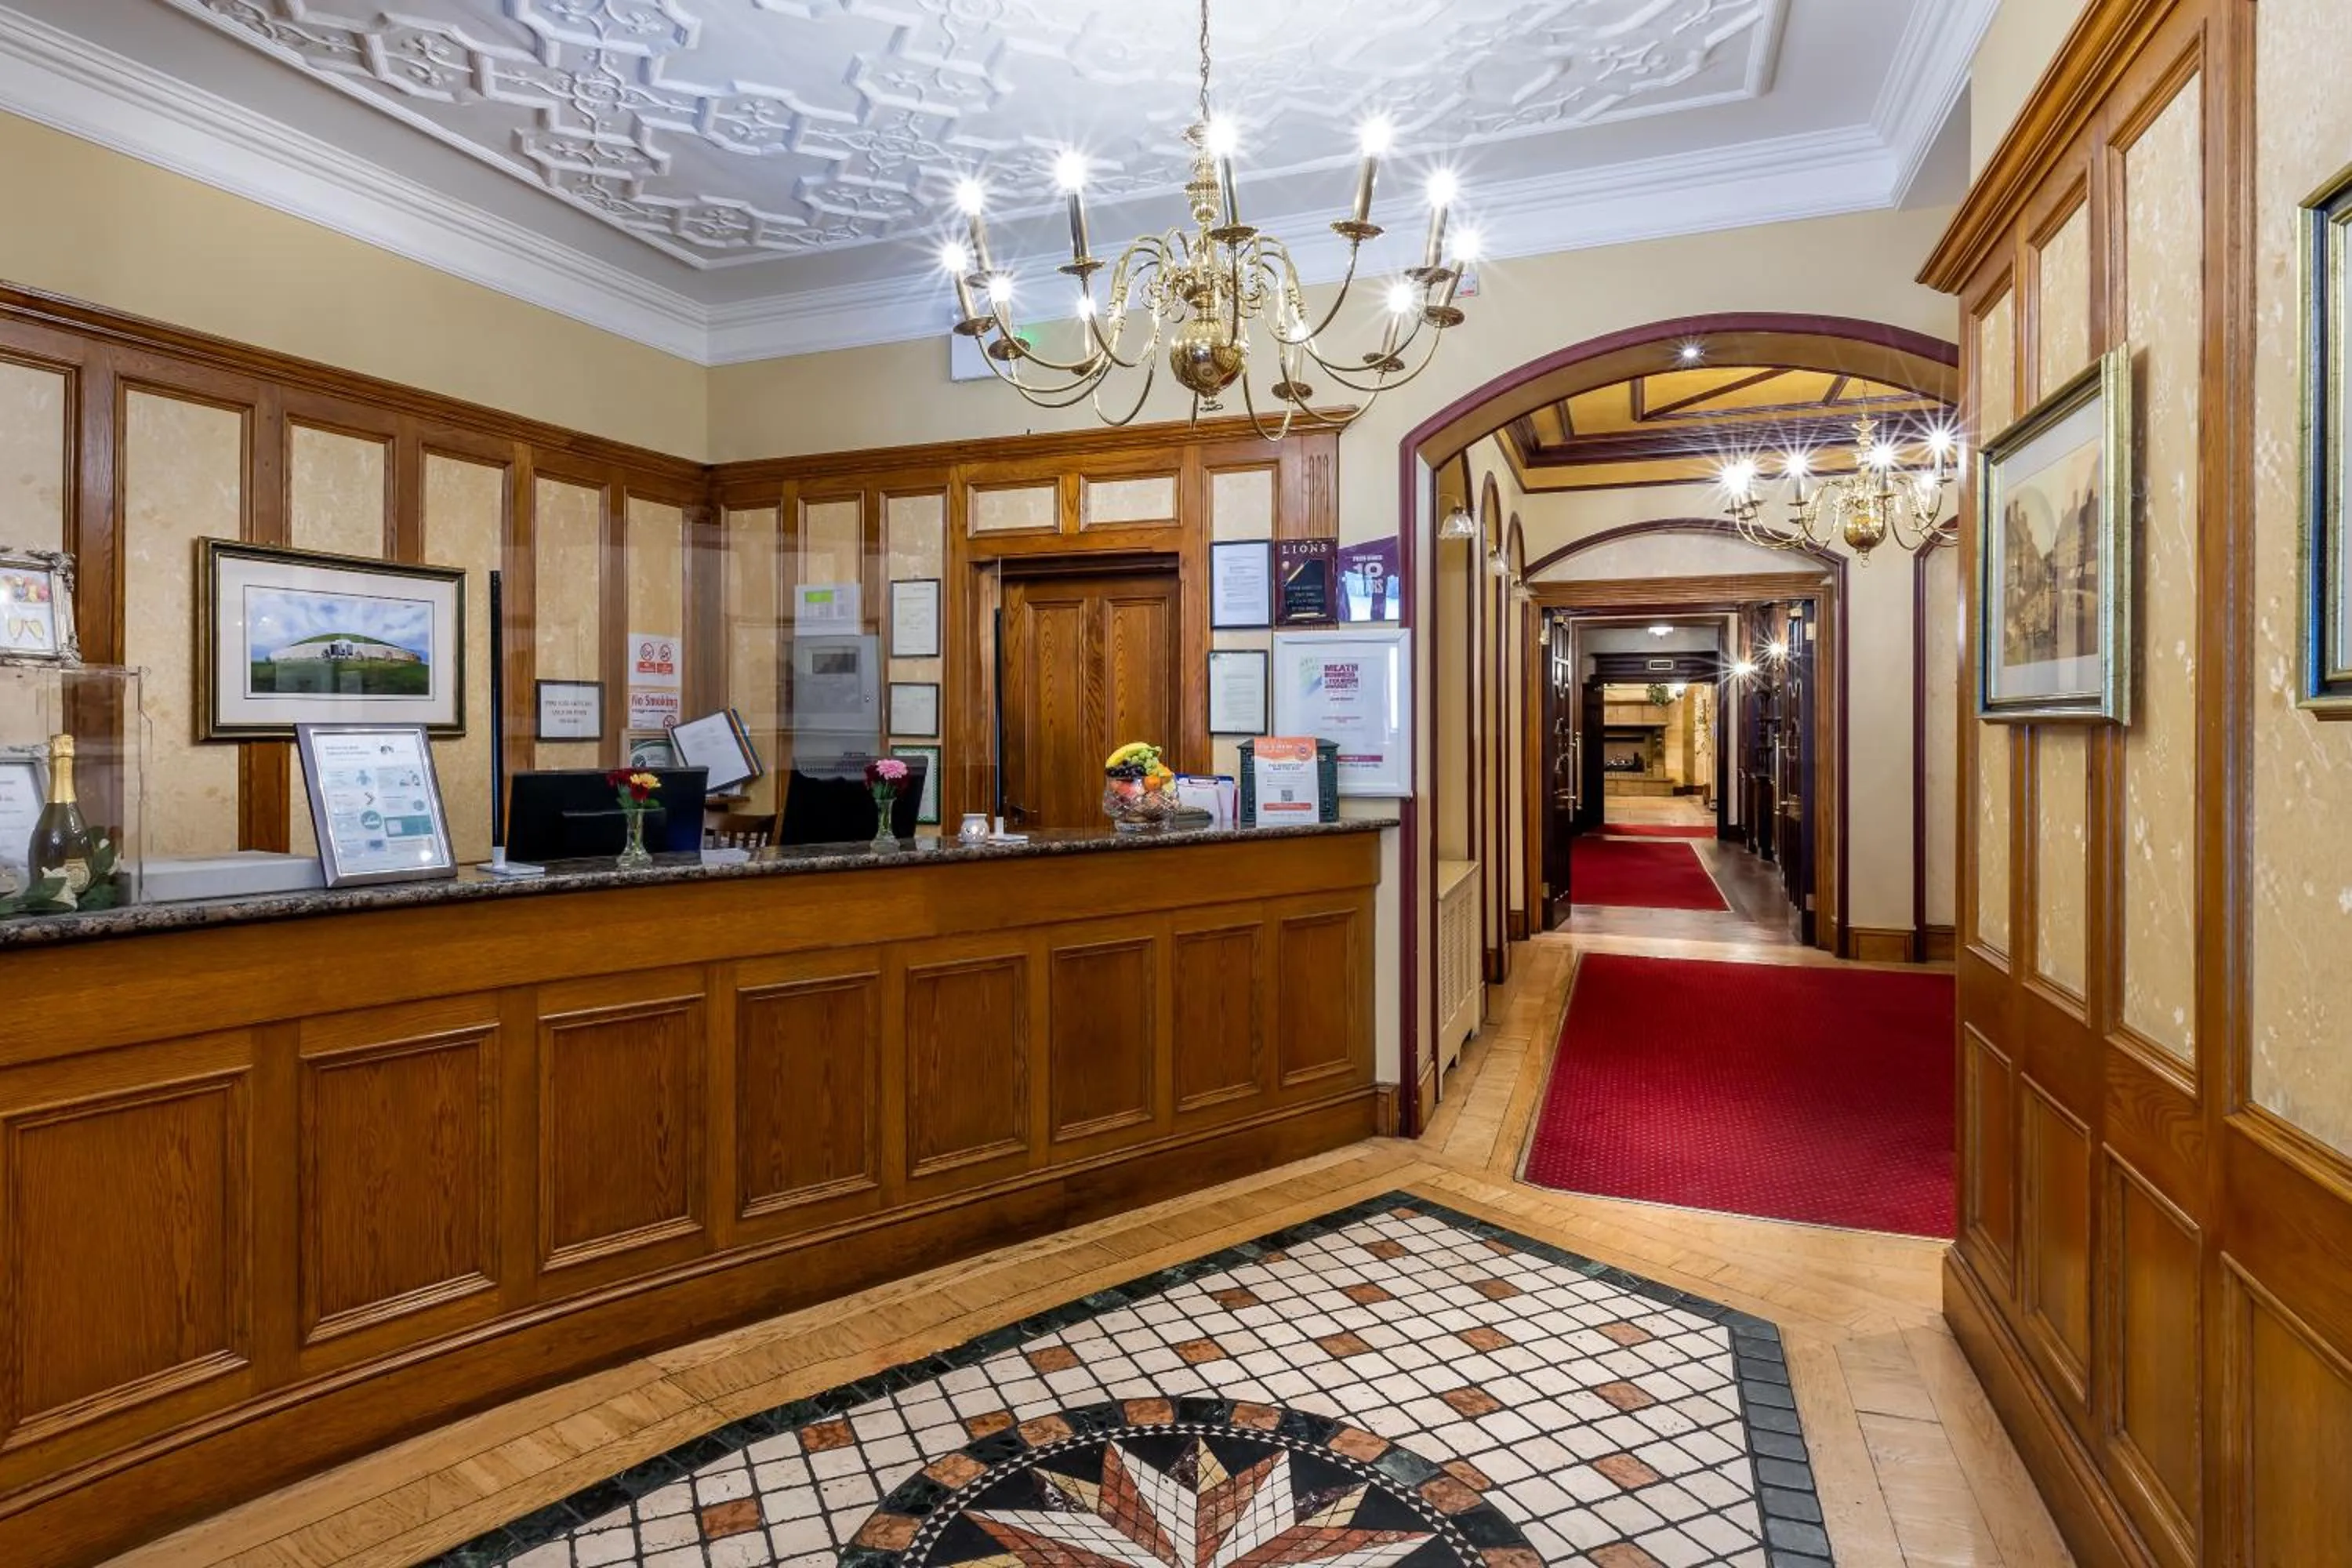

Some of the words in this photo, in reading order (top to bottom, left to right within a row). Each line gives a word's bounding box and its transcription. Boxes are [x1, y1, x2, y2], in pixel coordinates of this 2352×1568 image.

[1281, 543, 1329, 555] LIONS
[1352, 562, 1384, 578] 10
[1324, 663, 1359, 672] MEATH
[631, 694, 643, 706] No
[645, 695, 678, 710] Smoking
